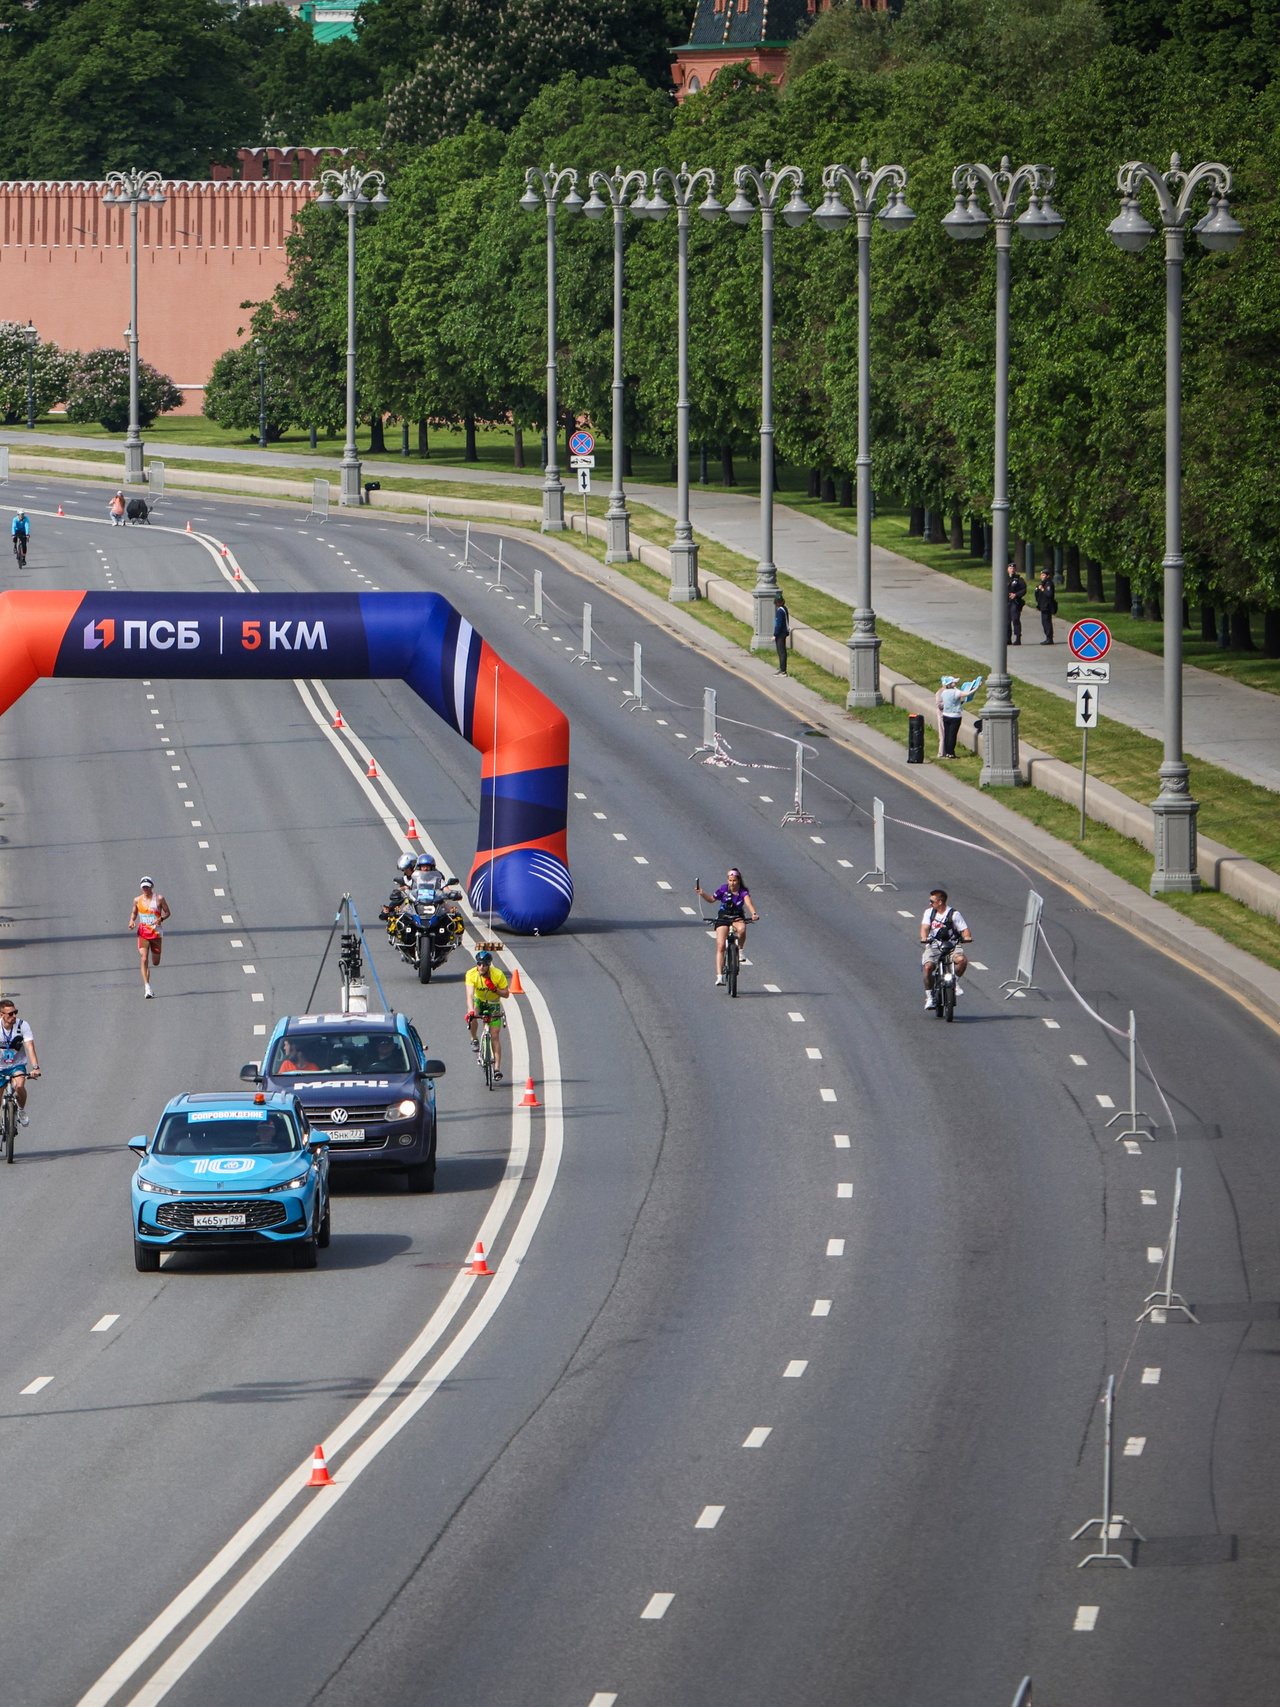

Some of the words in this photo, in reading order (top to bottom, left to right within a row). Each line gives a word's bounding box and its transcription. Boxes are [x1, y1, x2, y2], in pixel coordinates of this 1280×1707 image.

[123, 620, 201, 650] ПСБ
[241, 621, 262, 650] 5
[269, 621, 328, 650] КМ
[293, 1080, 389, 1090] МАТЧ!
[191, 1111, 264, 1120] СОПРОВОЖДЕНИЕ
[189, 1157, 256, 1174] 10
